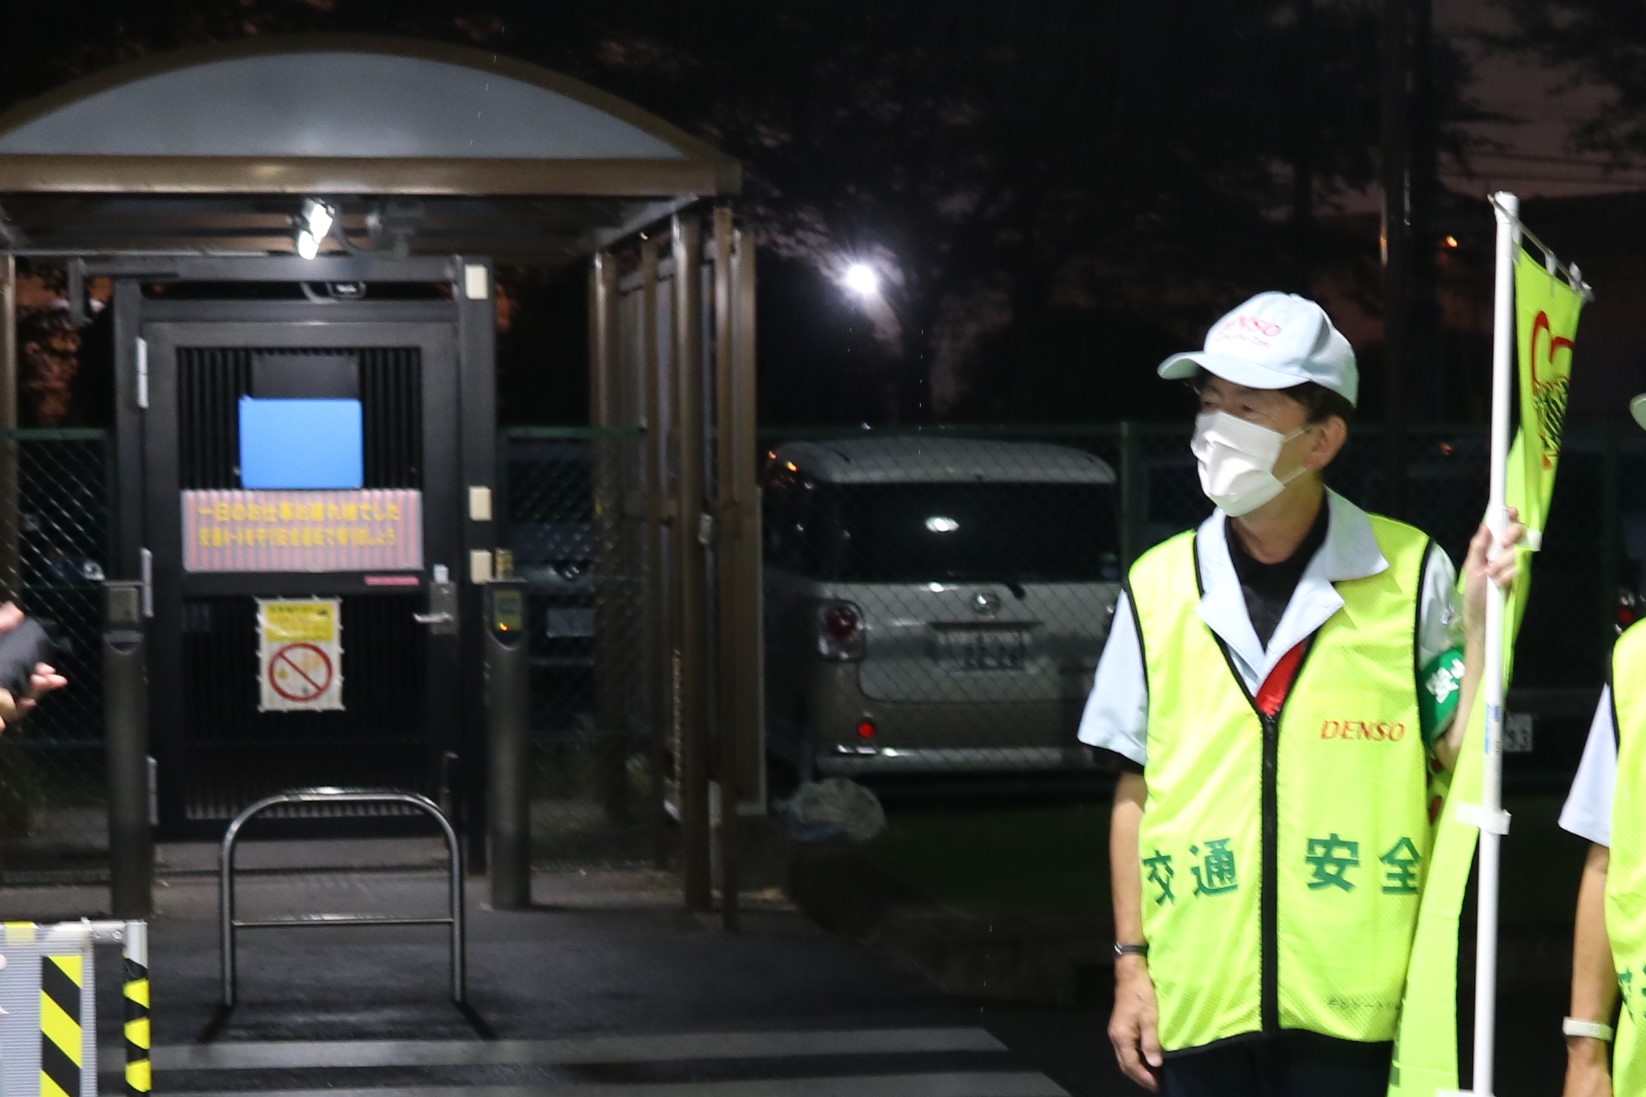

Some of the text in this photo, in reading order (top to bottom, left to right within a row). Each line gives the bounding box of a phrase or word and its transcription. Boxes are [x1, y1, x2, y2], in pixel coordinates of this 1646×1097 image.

[1320, 719, 1406, 742] DENSO
[1143, 833, 1423, 905] 交通 安全
